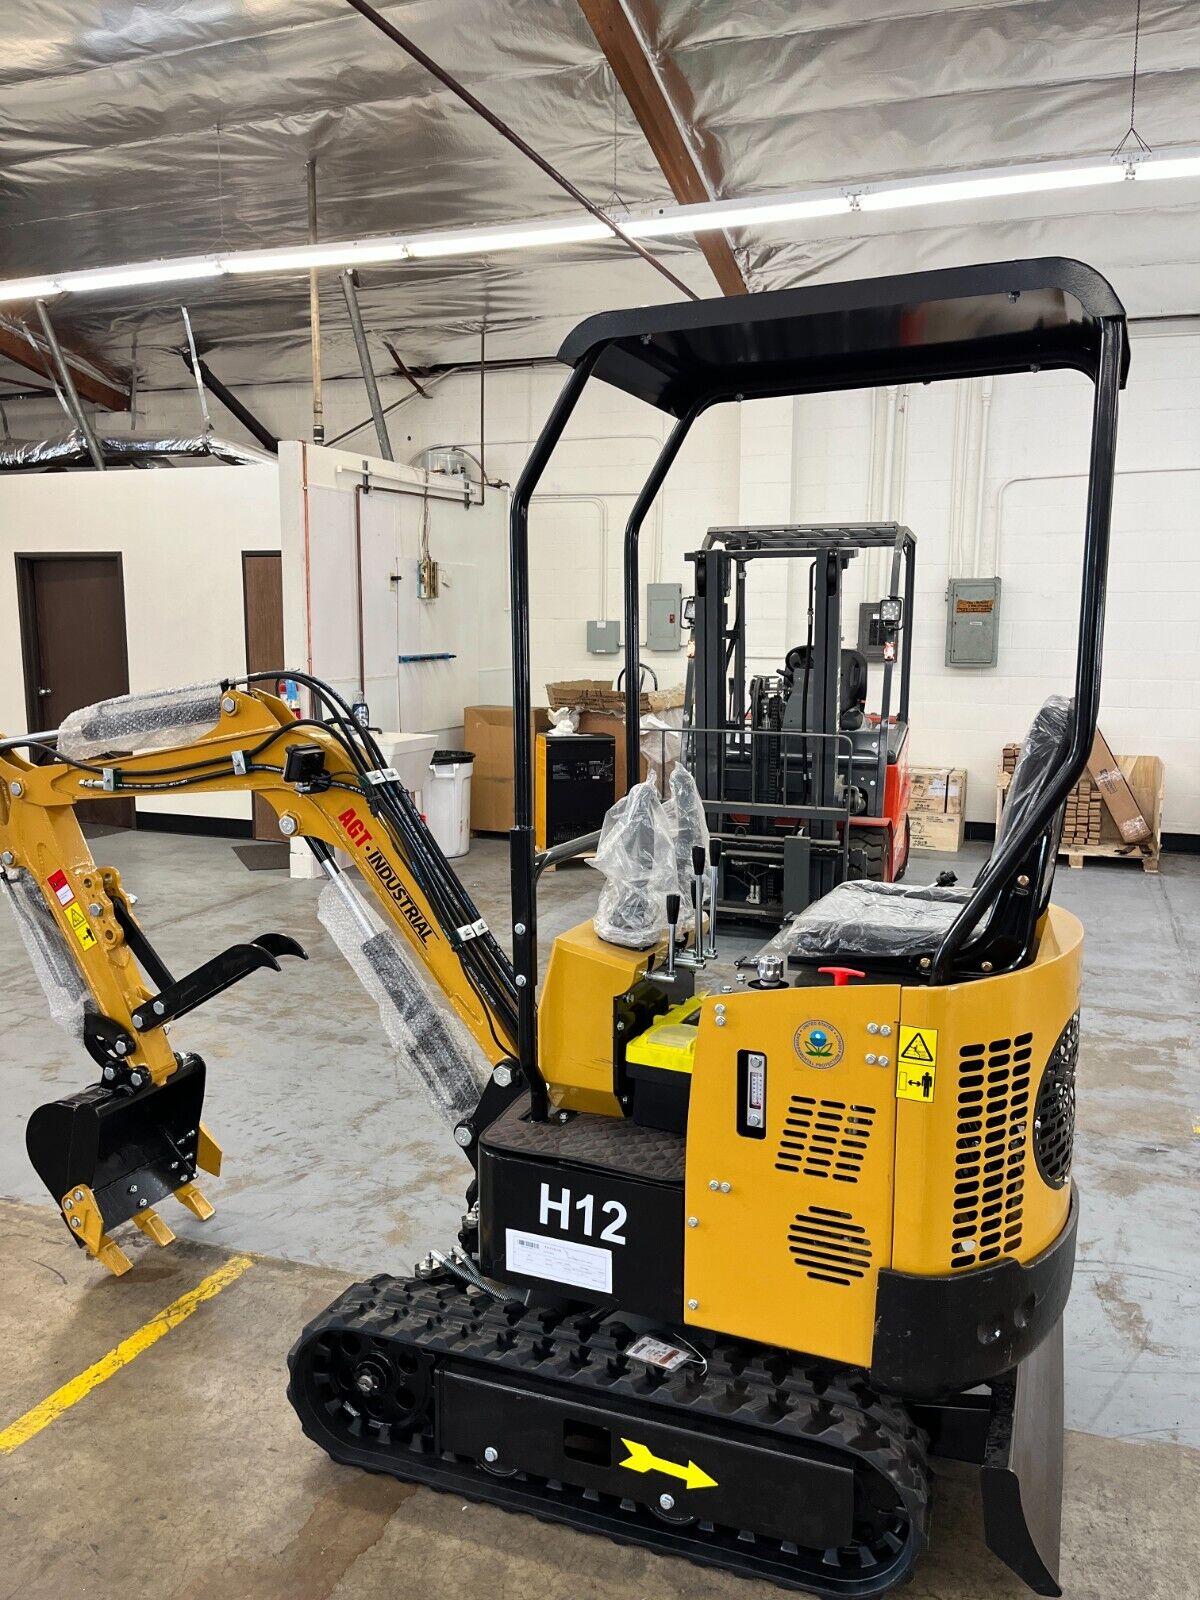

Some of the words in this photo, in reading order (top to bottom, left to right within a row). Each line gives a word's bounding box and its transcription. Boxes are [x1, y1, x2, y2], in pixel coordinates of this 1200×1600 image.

[338, 808, 373, 847] AGT
[368, 850, 434, 943] INDUSTRIAL
[539, 1182, 628, 1245] H12
